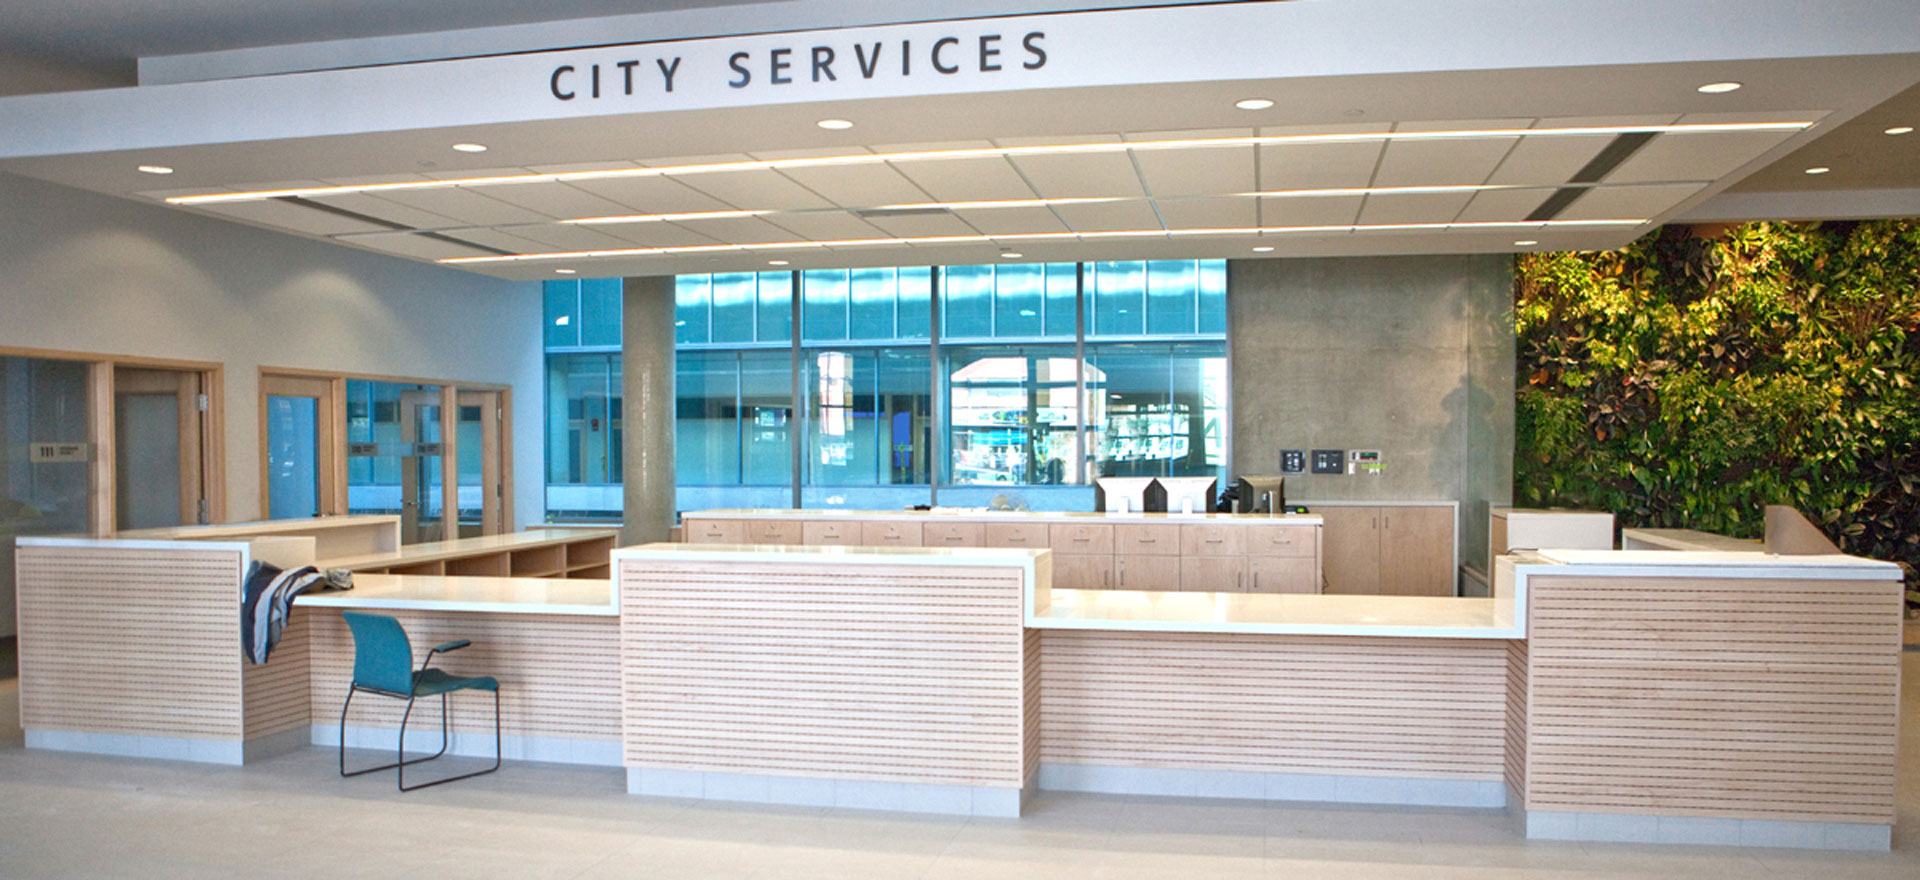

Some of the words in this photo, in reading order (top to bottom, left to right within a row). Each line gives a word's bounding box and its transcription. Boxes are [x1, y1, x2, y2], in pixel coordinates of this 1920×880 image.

[550, 57, 682, 101] CITY
[728, 31, 1049, 89] SERVICES
[40, 446, 54, 457] 111
